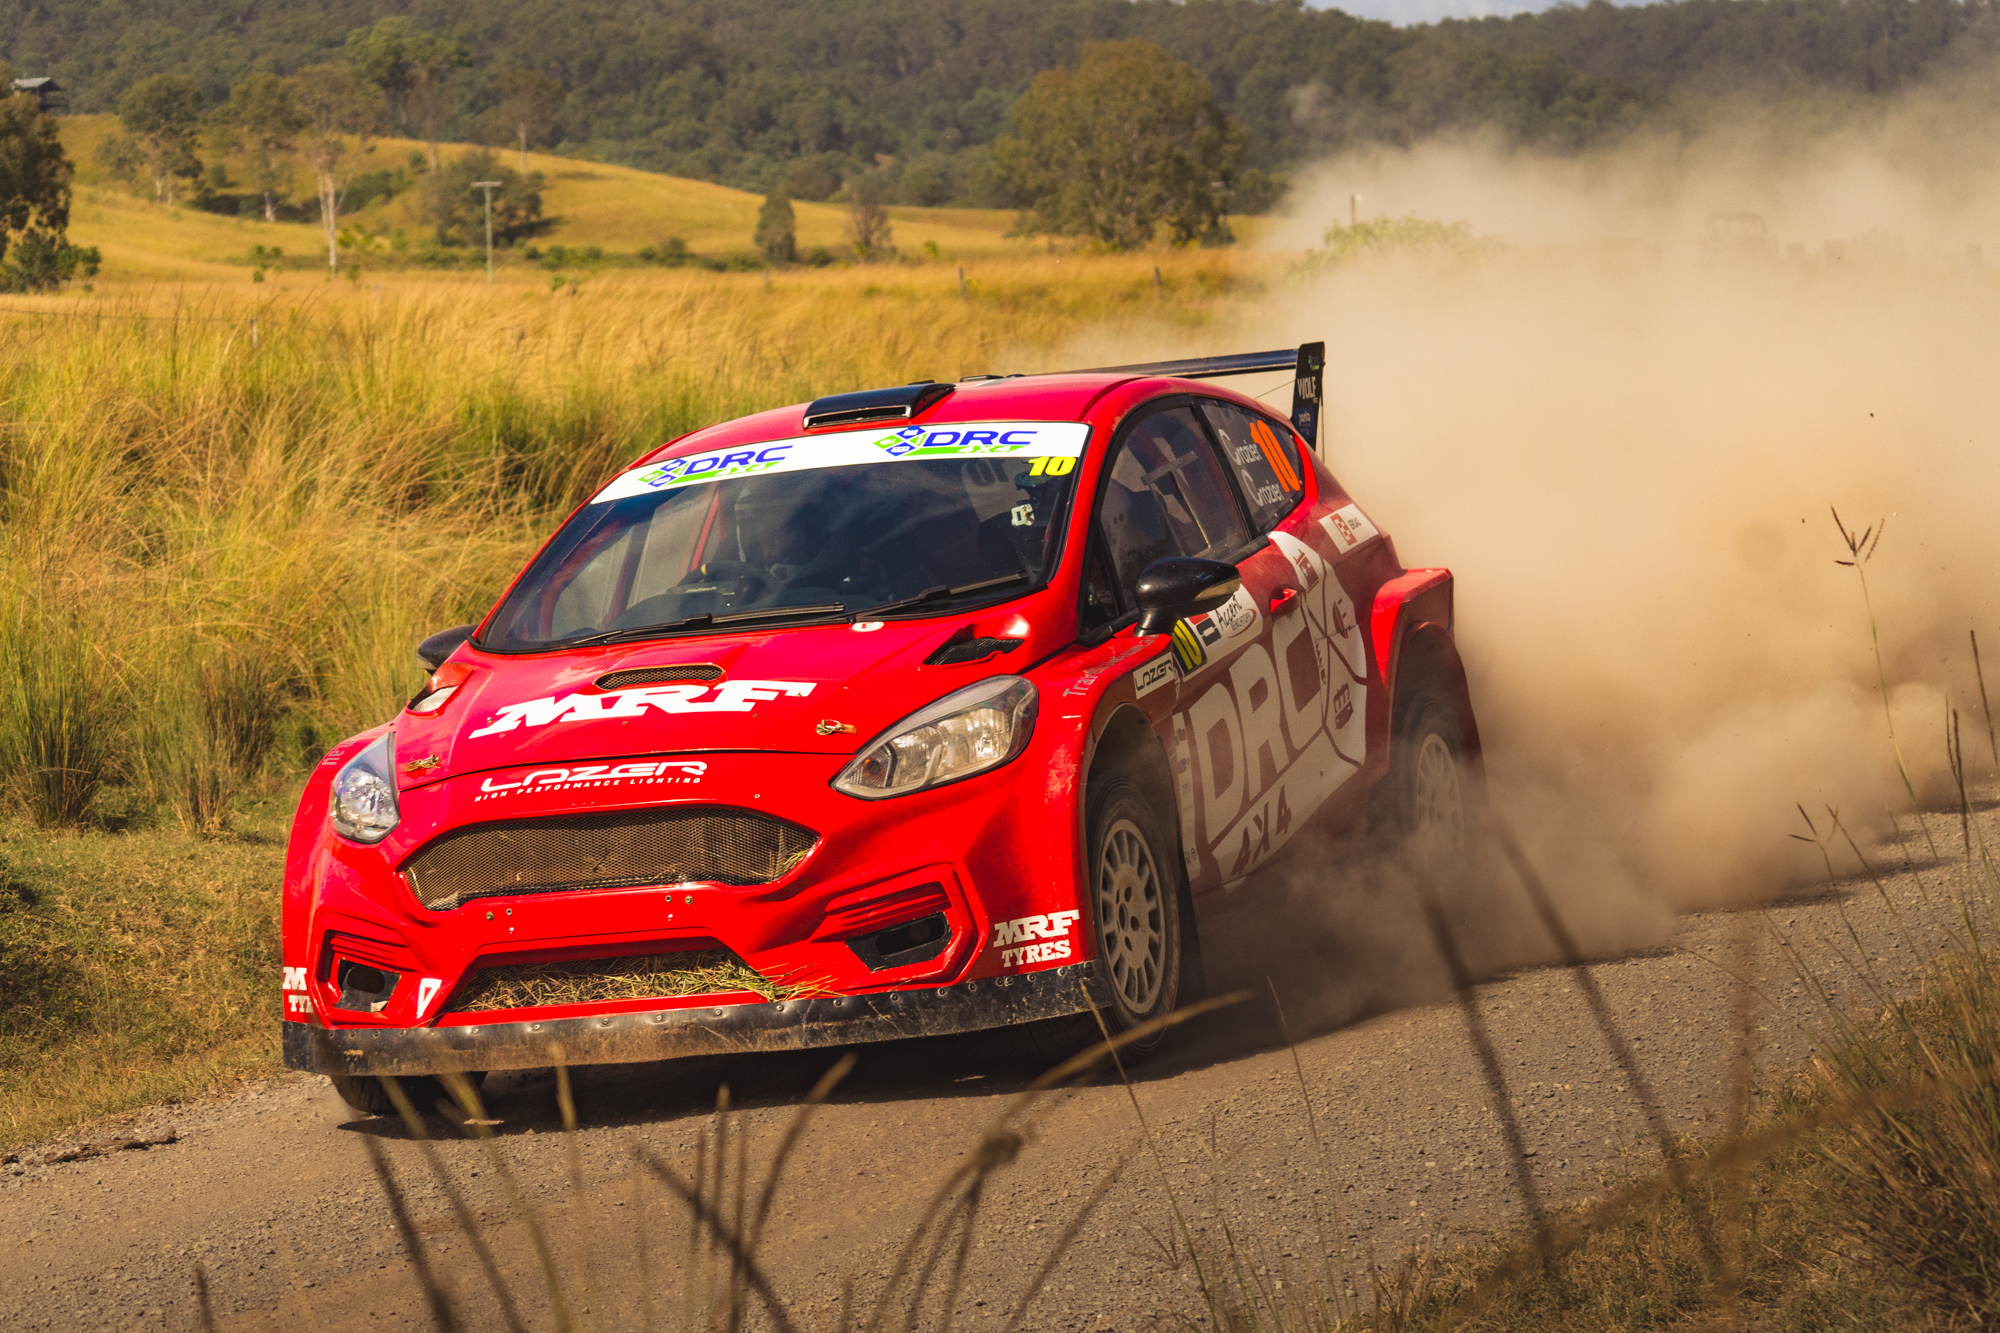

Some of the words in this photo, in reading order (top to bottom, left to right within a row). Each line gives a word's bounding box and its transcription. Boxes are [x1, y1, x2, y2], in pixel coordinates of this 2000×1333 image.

[1297, 376, 1316, 399] WOLF
[923, 431, 1038, 447] DRC
[1218, 429, 1262, 466] Crozier
[683, 445, 793, 476] DRC
[1028, 456, 1076, 476] 10
[1250, 420, 1300, 492] 10
[1242, 469, 1283, 507] Crozier
[1135, 659, 1174, 691] LAZER
[469, 680, 817, 738] MRF
[1188, 607, 1323, 844] DRC
[475, 790, 508, 802] HIGH
[516, 779, 621, 795] PERFORMANCE
[630, 776, 701, 786] LIGHTING
[480, 761, 707, 791] LAZER
[993, 909, 1080, 947] MRF
[1002, 939, 1071, 968] TYRES
